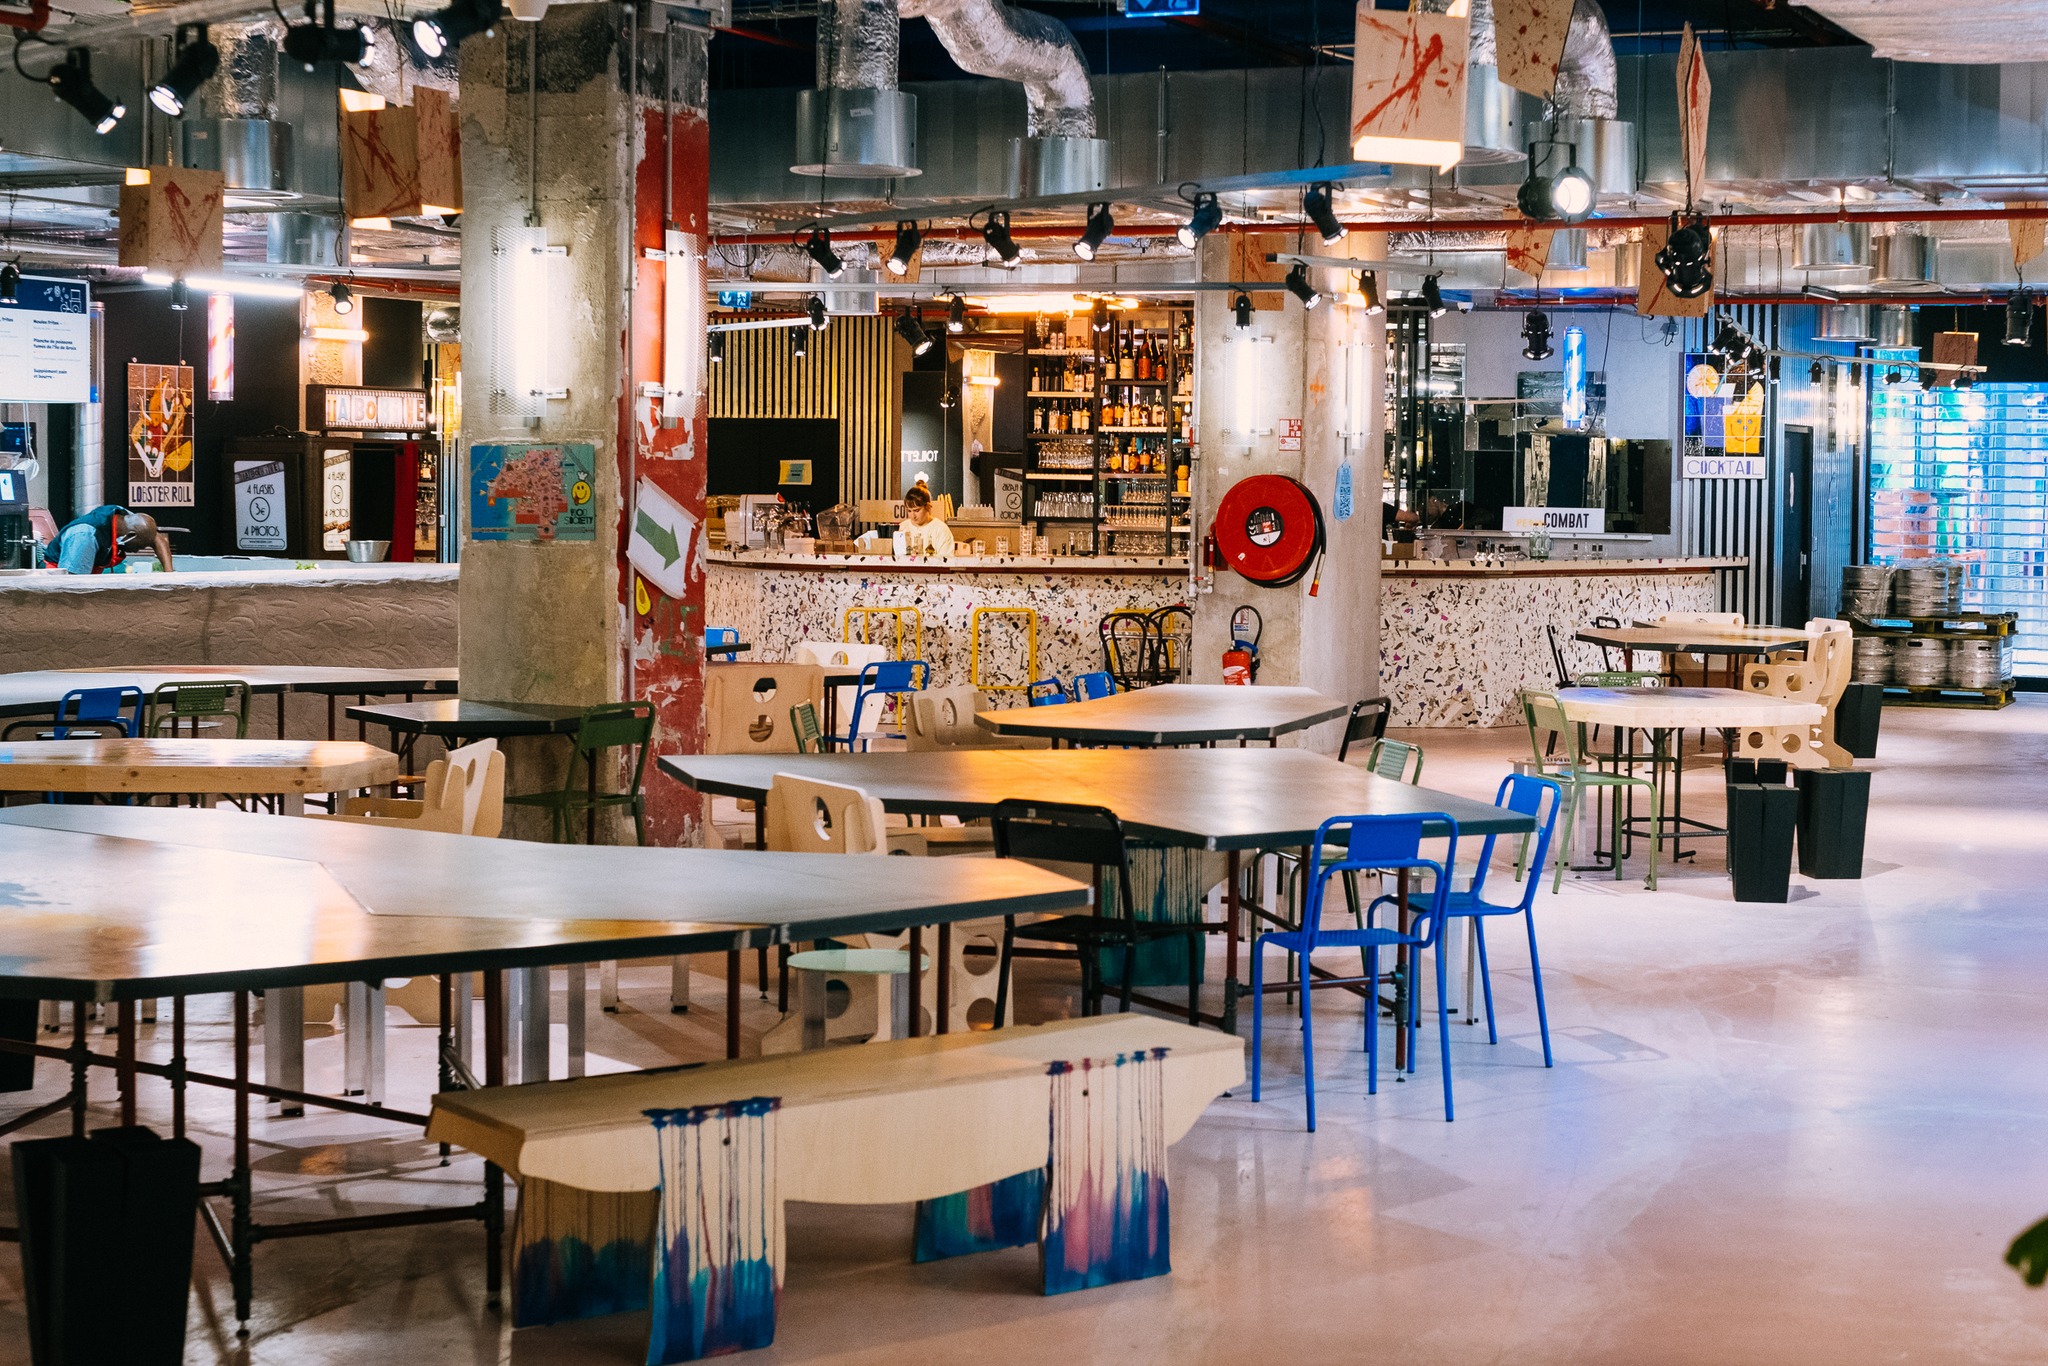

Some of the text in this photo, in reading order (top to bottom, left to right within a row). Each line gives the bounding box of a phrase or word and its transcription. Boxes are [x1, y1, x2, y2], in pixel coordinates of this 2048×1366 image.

[1686, 459, 1763, 476] COCKTAIL
[131, 485, 192, 503] LOBSTER ROLL
[1543, 512, 1590, 529] COMBAT
[251, 525, 280, 537] PHOTOS
